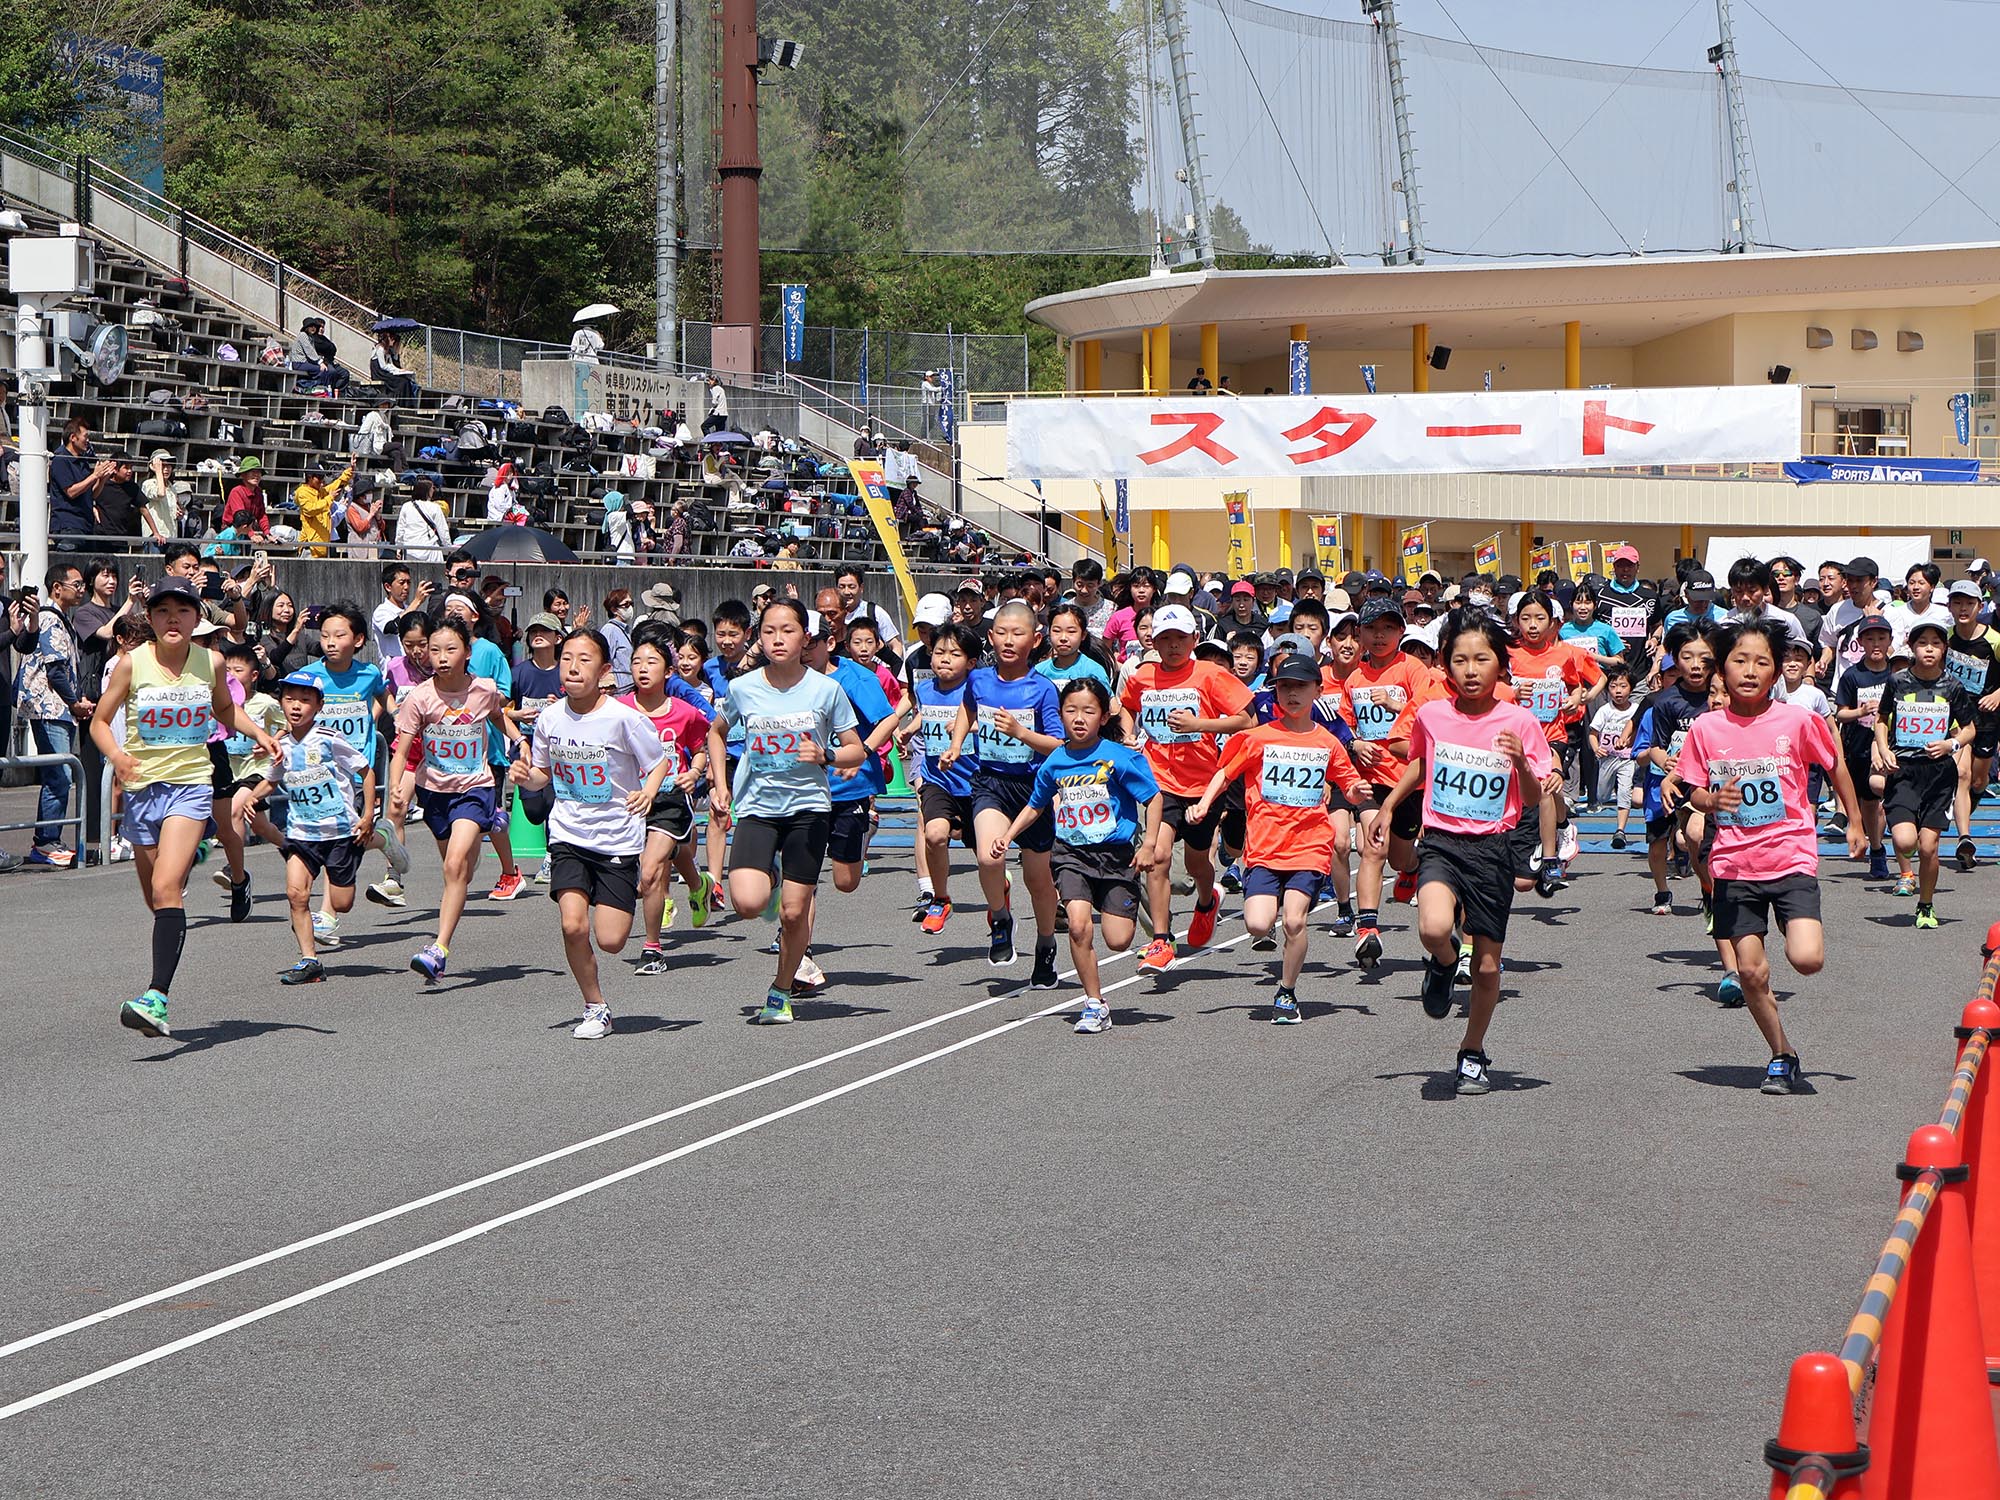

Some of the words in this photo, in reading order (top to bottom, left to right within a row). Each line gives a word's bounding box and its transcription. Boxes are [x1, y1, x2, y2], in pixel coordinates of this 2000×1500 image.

[605, 371, 671, 396] 岐阜県クリスタルパーク
[605, 391, 686, 426] 恵那スケ場
[1137, 400, 1656, 465] スタート
[1831, 468, 1870, 481] SPORTS
[1870, 465, 1923, 482] Alpen
[1613, 617, 1646, 629] 5074
[1946, 661, 1983, 684] 4411
[1521, 693, 1557, 709] 515
[140, 706, 207, 728] 4505
[1354, 705, 1397, 724] 405
[436, 726, 482, 737] JAひがしみの
[1897, 716, 1947, 734] 4524
[426, 740, 477, 759] 4501
[1279, 751, 1329, 762] JAひがしみの
[1450, 751, 1512, 769] JAひがしみの
[553, 762, 606, 786] 4513
[1264, 765, 1325, 789] 4422
[1718, 763, 1775, 777] JAひがしみの
[1433, 766, 1506, 801] 4409
[290, 782, 335, 807] 4431
[1063, 789, 1107, 801] Aひがしみの
[1056, 803, 1110, 829] 4509
